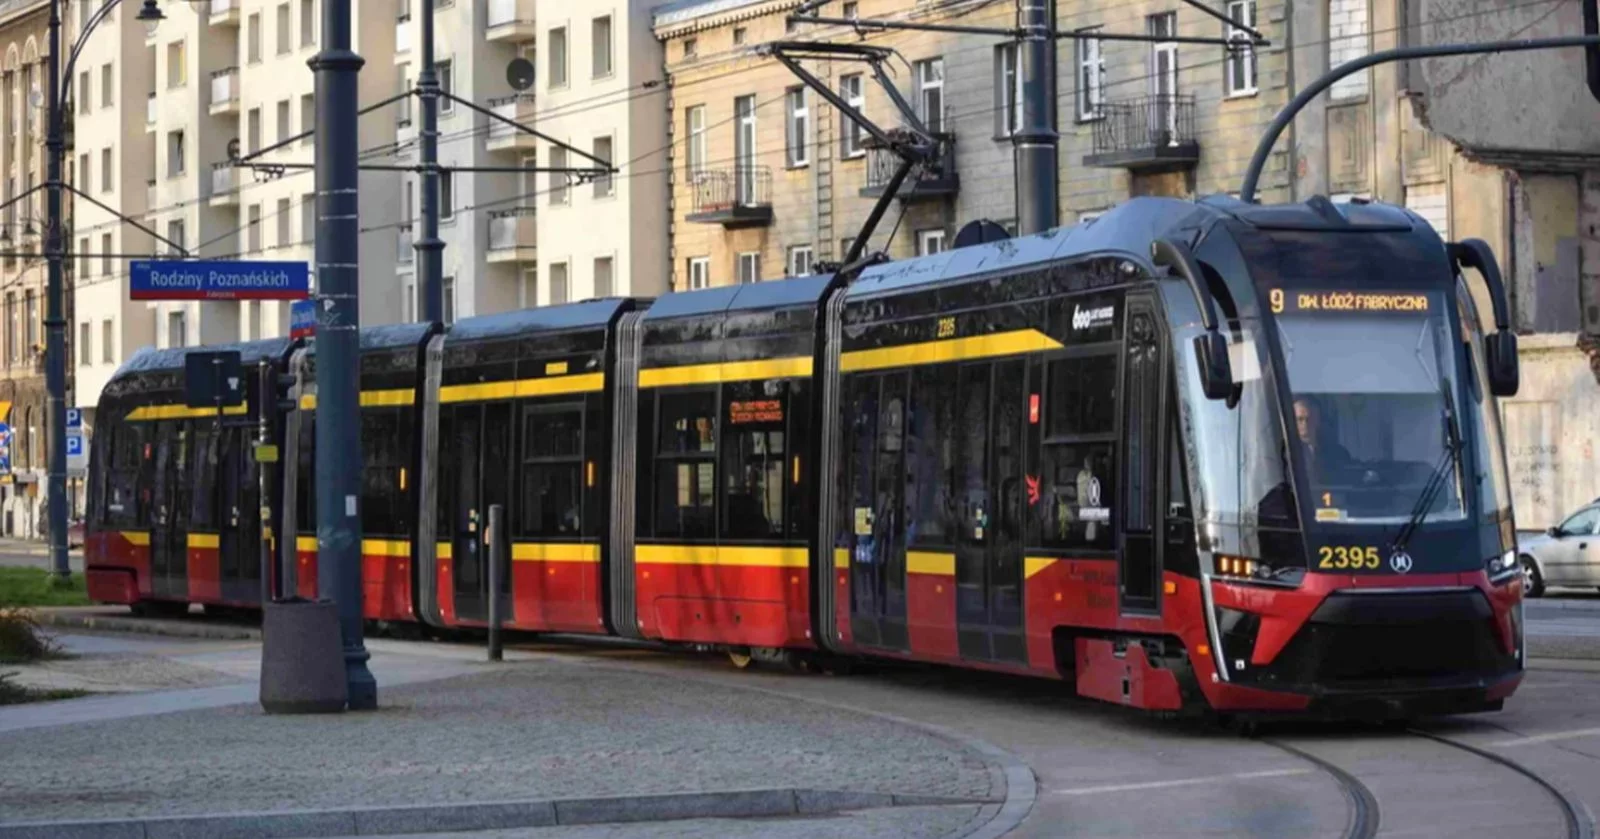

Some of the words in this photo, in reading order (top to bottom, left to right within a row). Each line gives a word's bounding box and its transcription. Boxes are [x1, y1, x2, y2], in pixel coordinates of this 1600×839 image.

[151, 271, 202, 290] Rodziny
[209, 271, 289, 287] Poznańskich
[1270, 288, 1284, 313] 9
[1355, 294, 1428, 310] FABRYCZNA
[67, 409, 78, 425] P
[67, 437, 78, 453] P
[1322, 492, 1332, 507] 1
[1319, 546, 1380, 569] 2395
